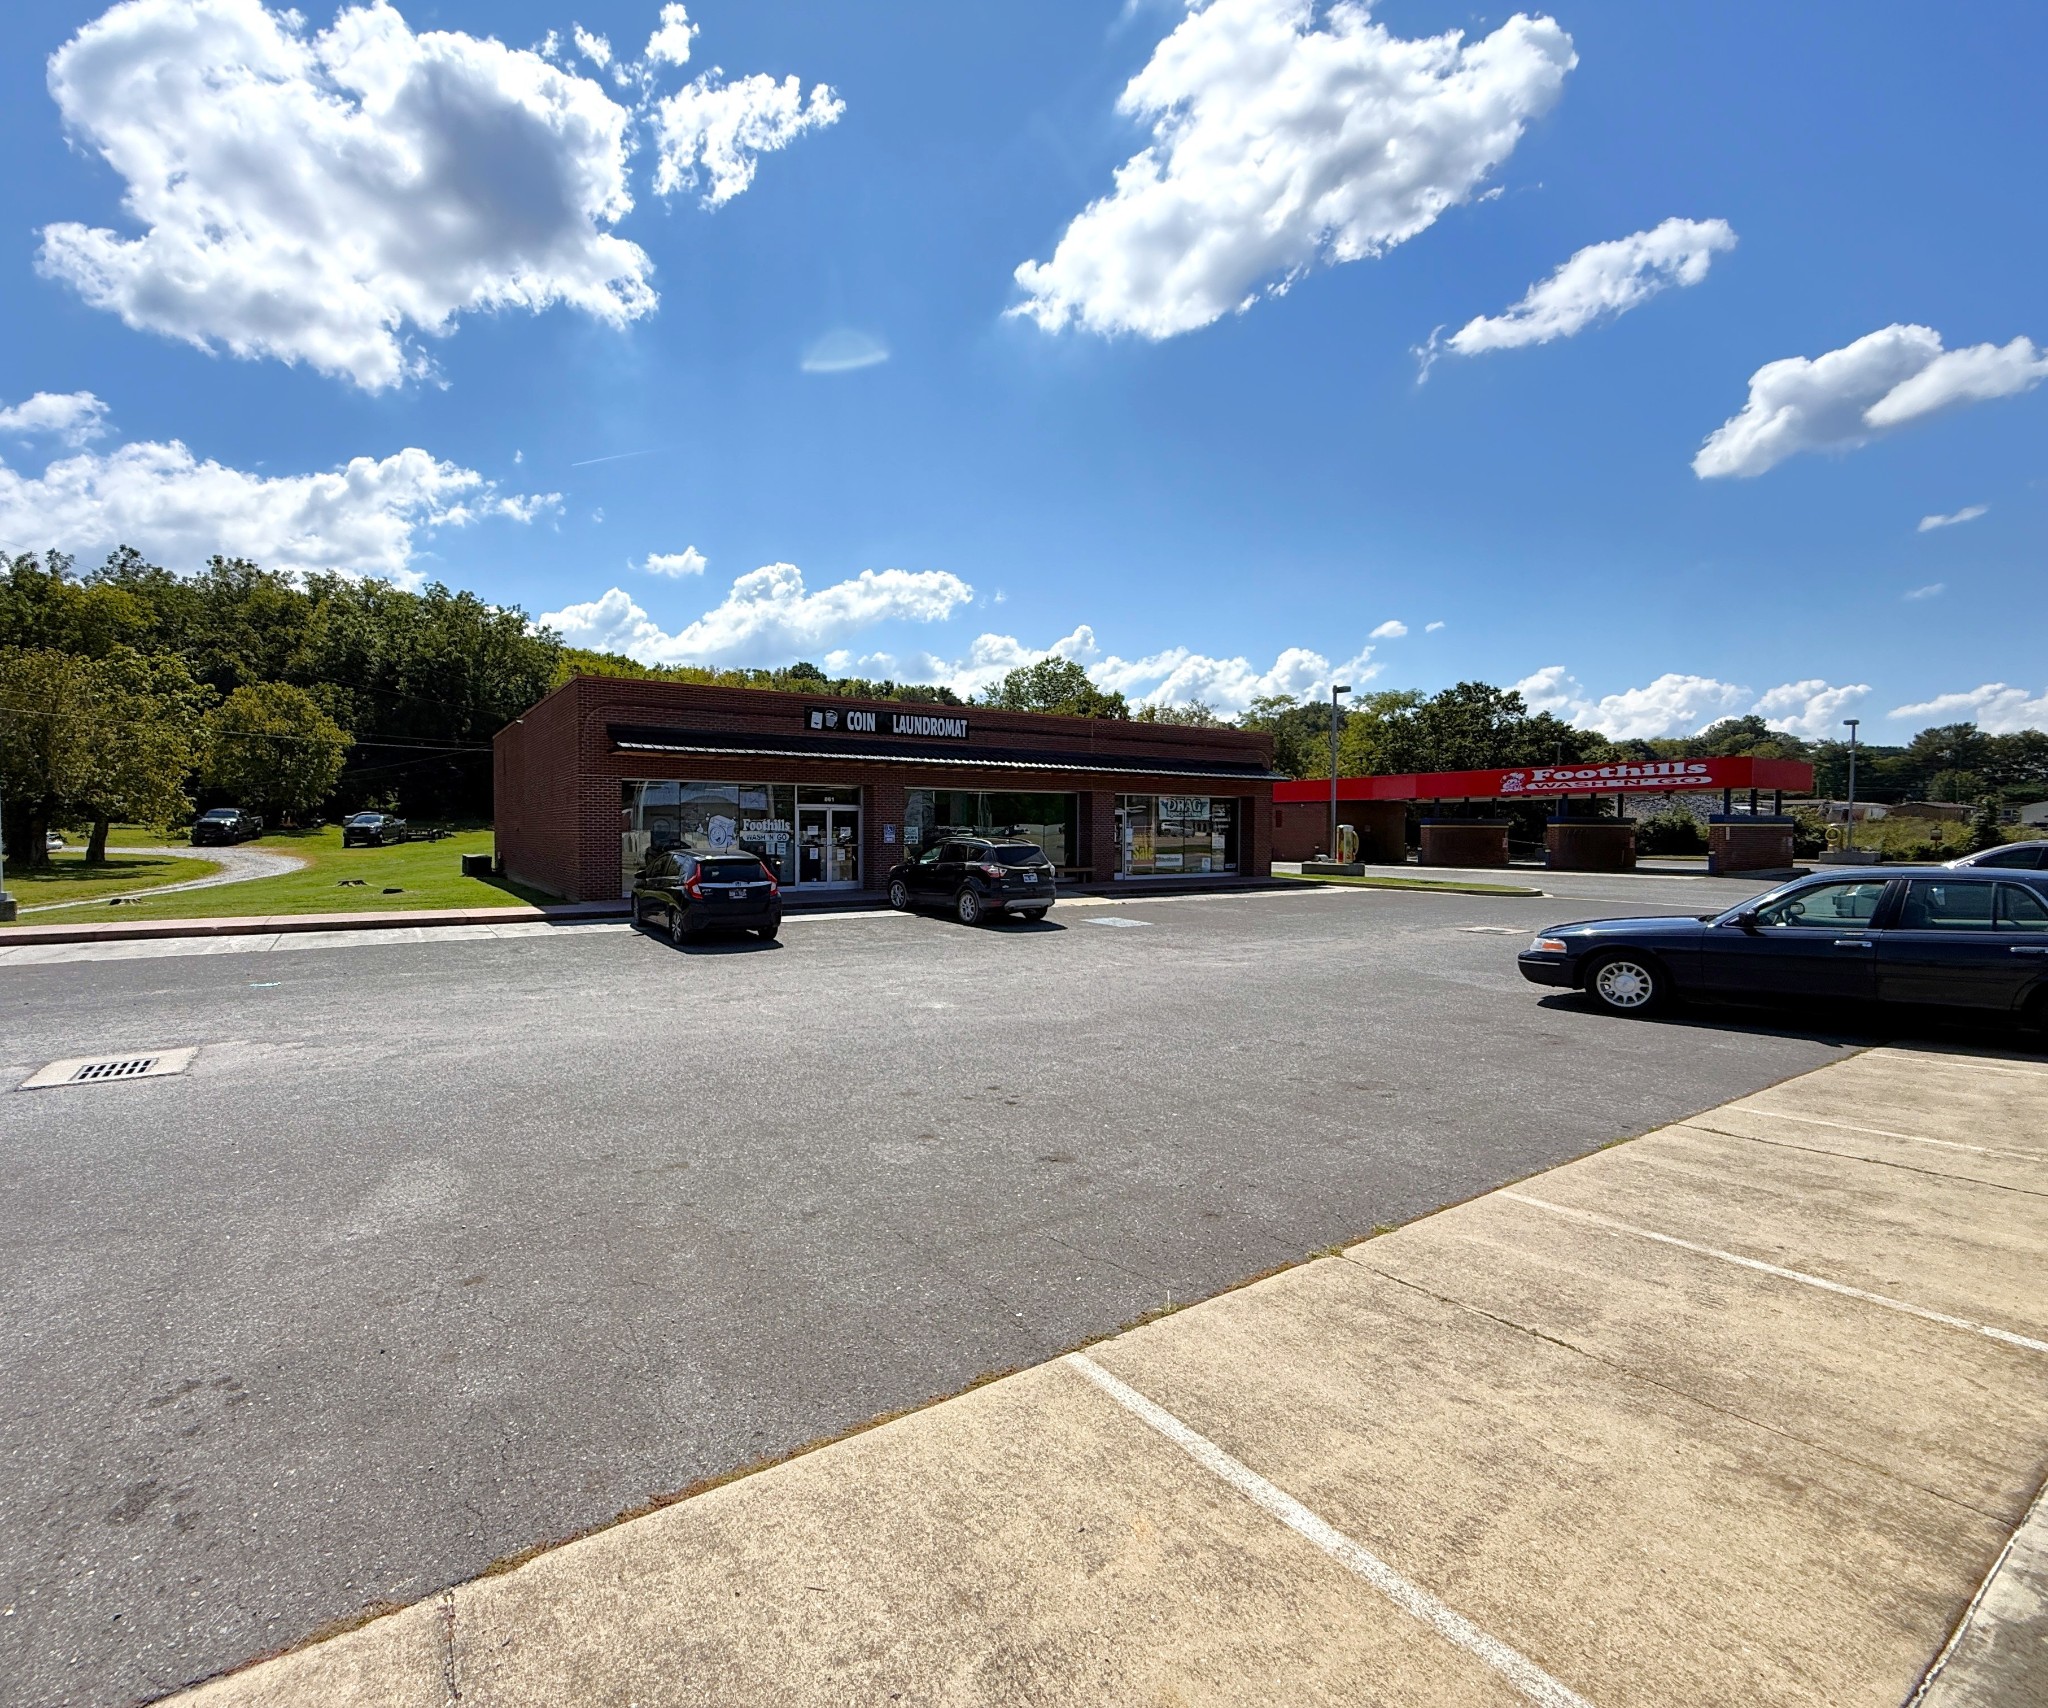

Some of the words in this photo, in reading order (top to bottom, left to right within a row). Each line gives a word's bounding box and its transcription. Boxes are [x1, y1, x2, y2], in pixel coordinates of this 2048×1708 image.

[847, 712, 876, 731] COIN
[893, 715, 968, 737] LAUNDROMAT
[1532, 762, 1707, 781] Foothills
[1168, 799, 1201, 812] DRAG
[743, 819, 791, 831] Foothills
[1133, 845, 1154, 861] Sale
